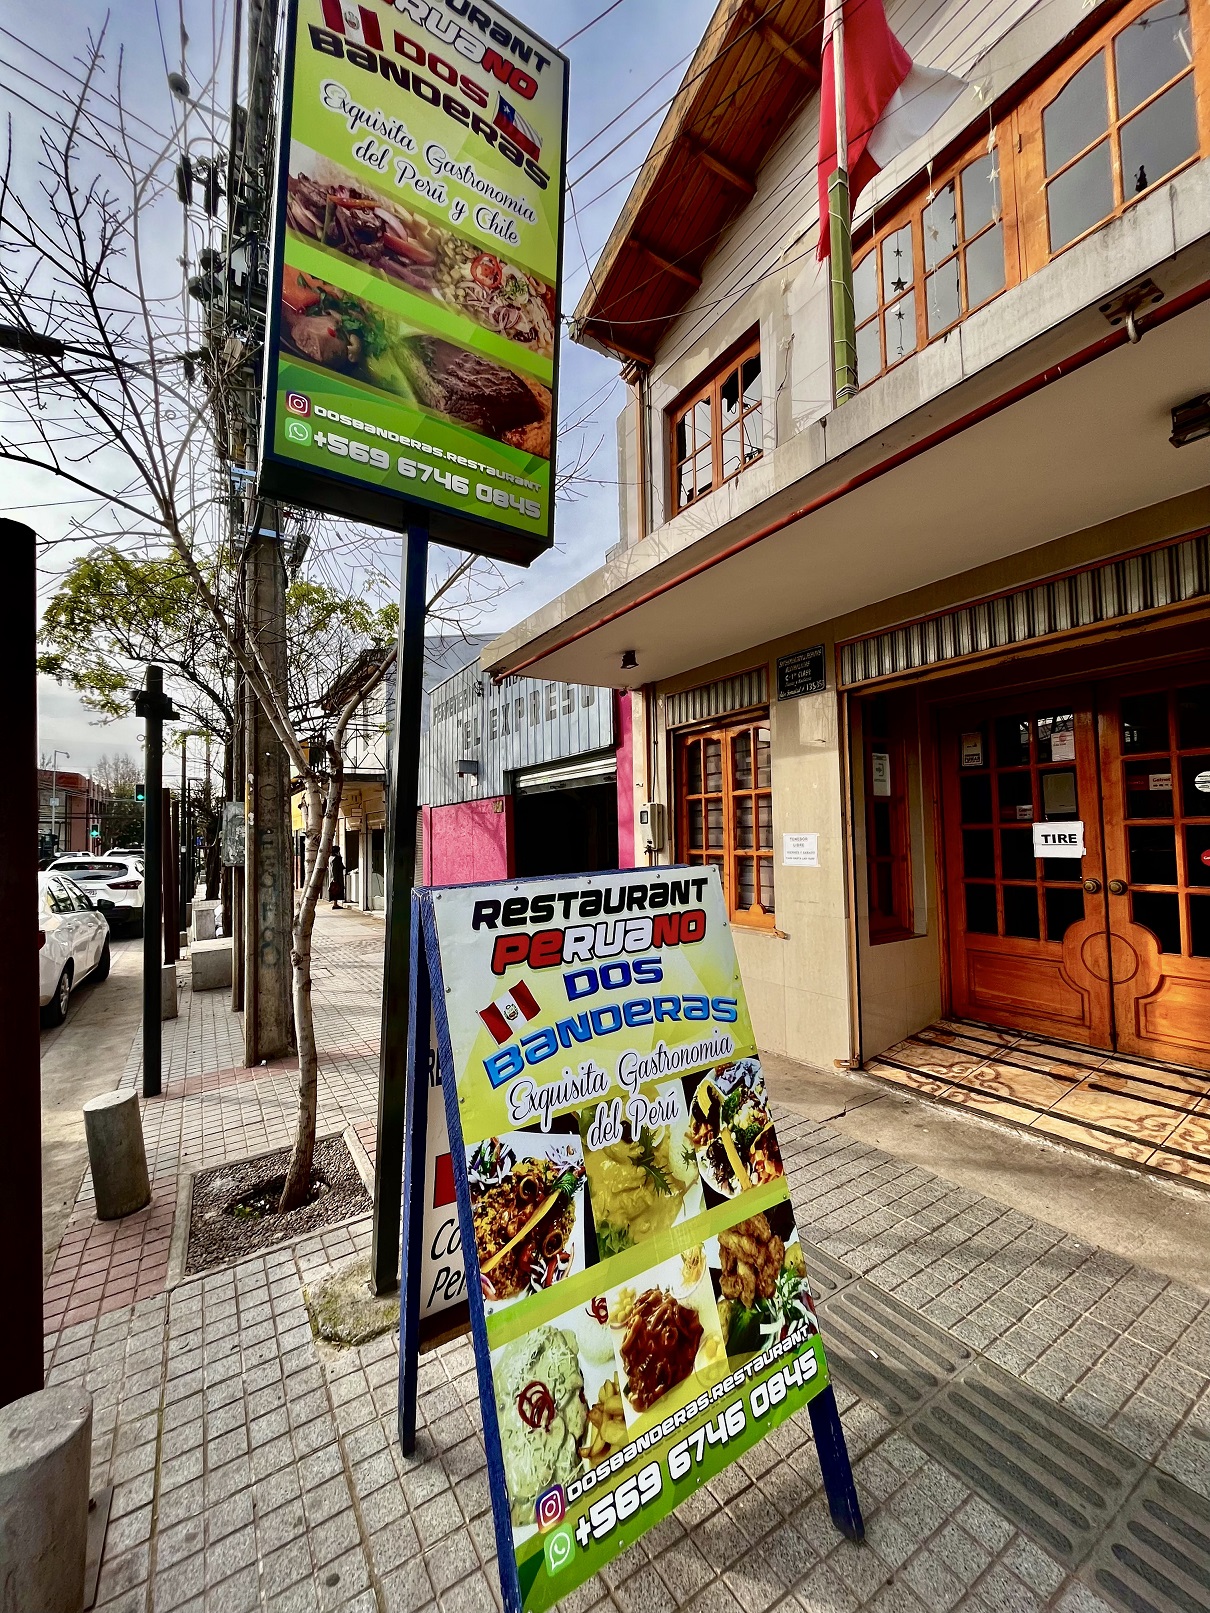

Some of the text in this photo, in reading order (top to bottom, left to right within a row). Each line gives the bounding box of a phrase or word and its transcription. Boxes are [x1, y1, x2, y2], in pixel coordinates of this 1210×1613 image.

[394, 30, 489, 108] DOS
[323, 82, 415, 151] Exquisita
[355, 141, 389, 170] del
[453, 200, 466, 221] y
[476, 207, 518, 243] Chile
[314, 430, 541, 518] +569 6746 0845
[1041, 833, 1077, 843] TIRE
[563, 957, 664, 1001] DOS
[509, 1062, 608, 1128] Exquisita
[618, 1029, 734, 1094] Gastronomia
[591, 1091, 679, 1148] del Perú
[575, 1349, 818, 1546] +569 6746 0845
